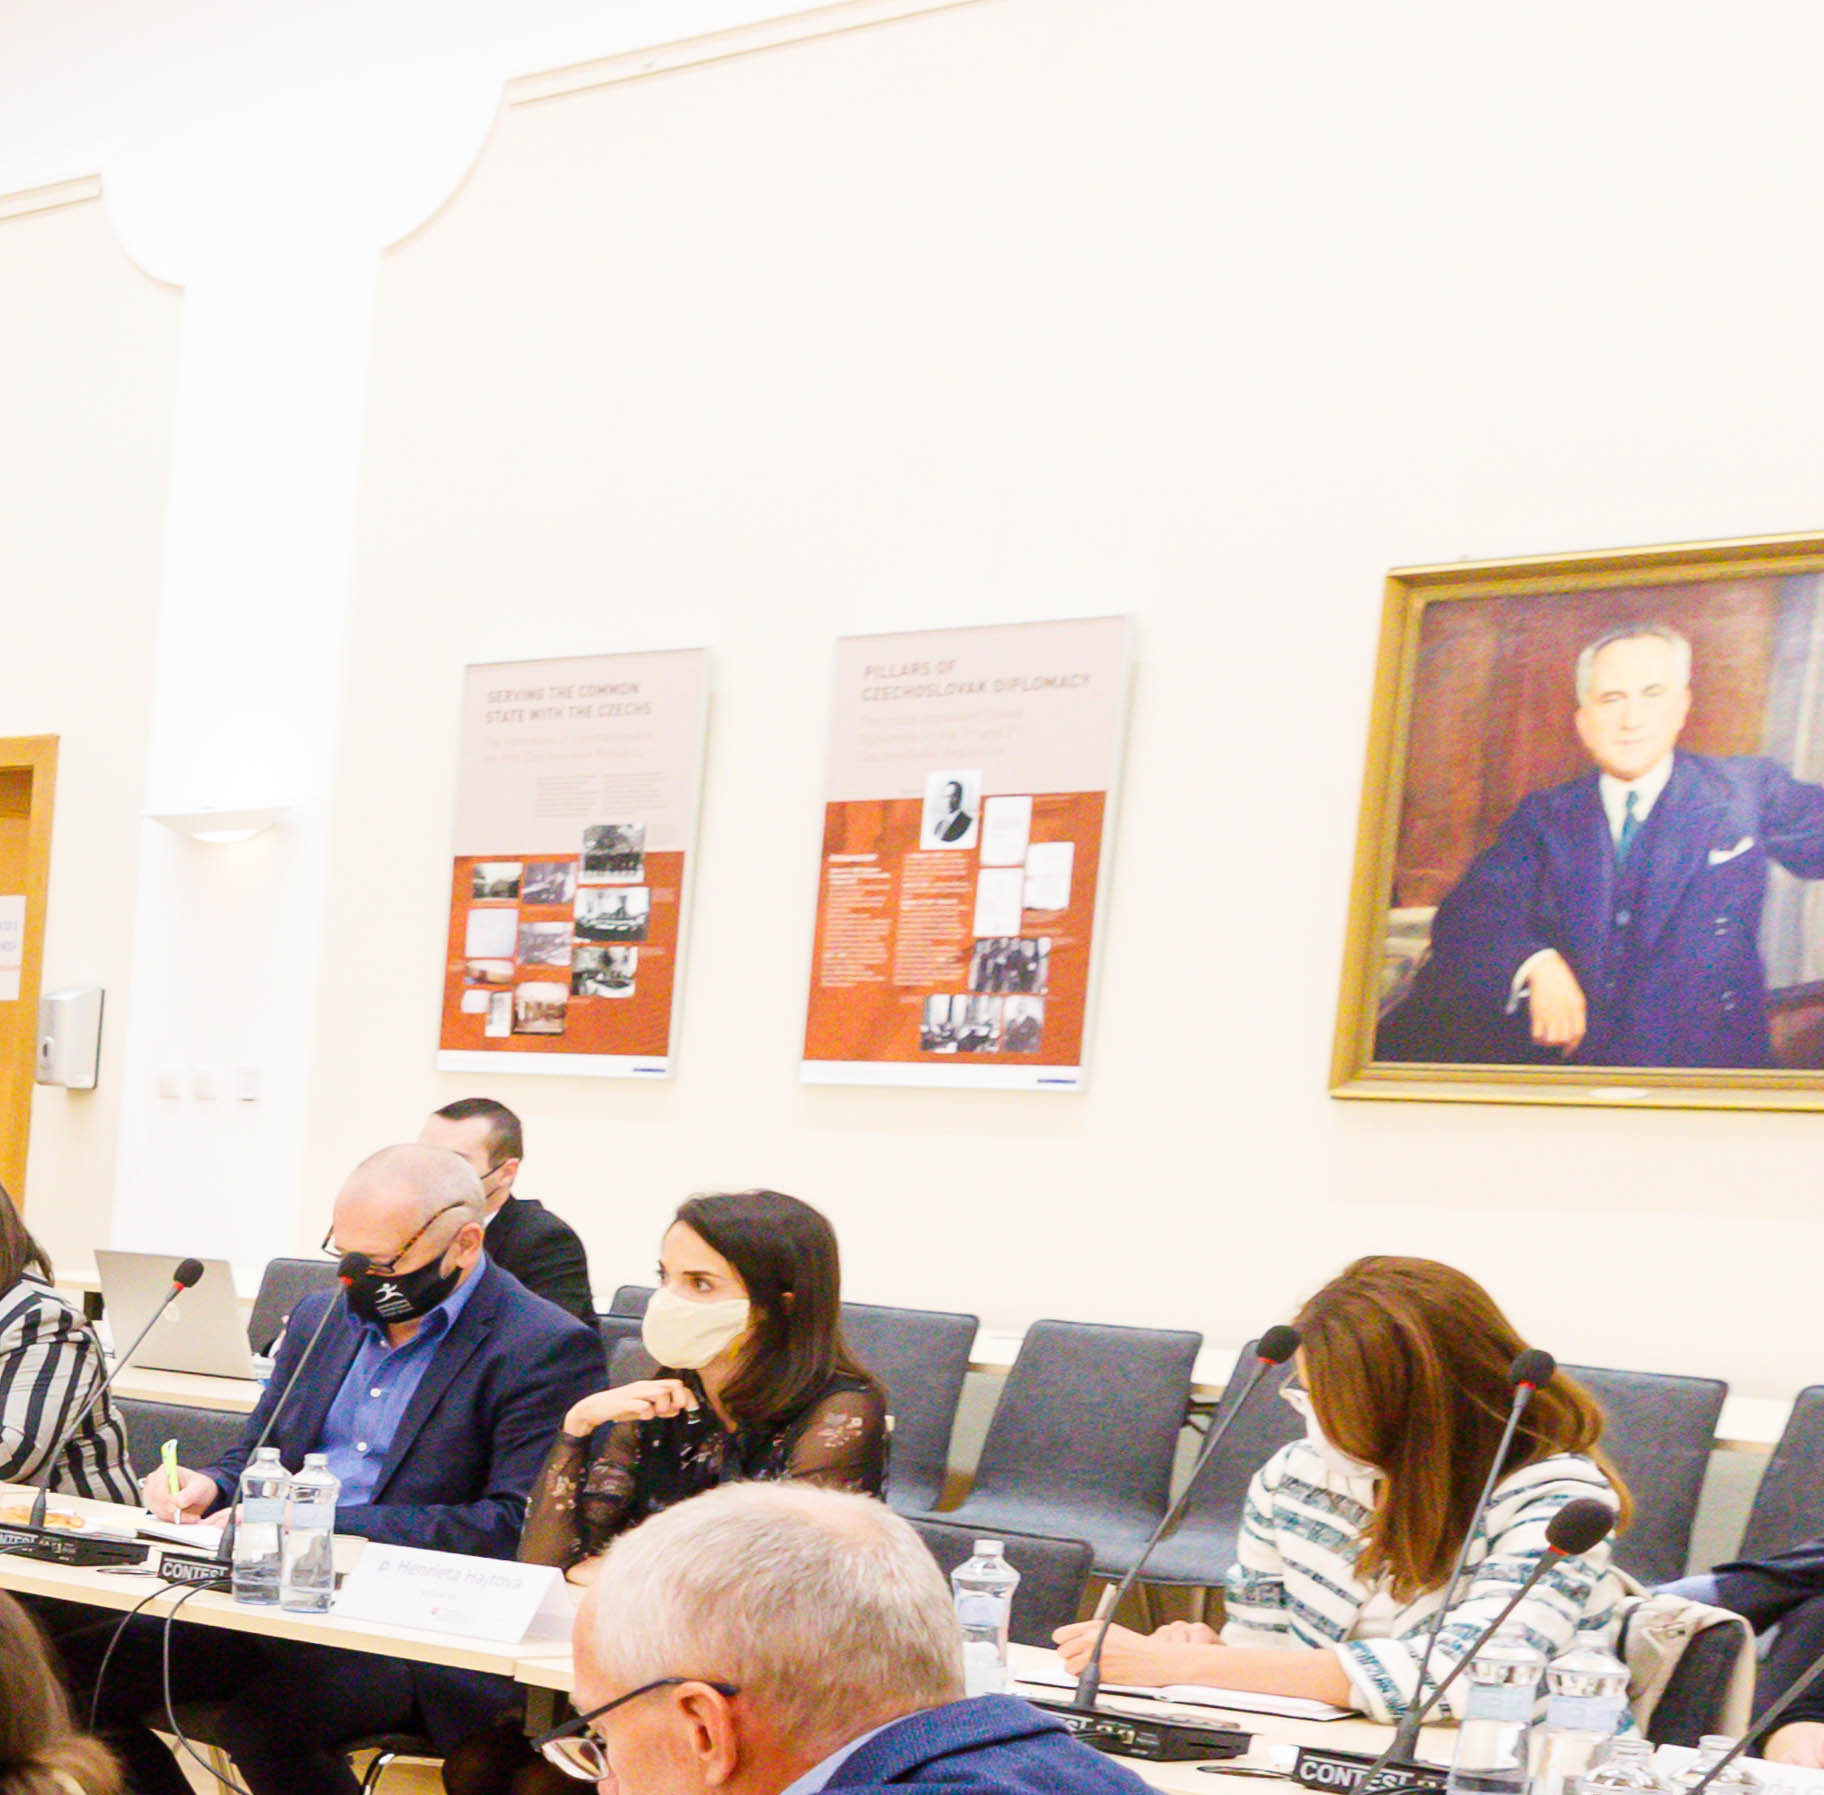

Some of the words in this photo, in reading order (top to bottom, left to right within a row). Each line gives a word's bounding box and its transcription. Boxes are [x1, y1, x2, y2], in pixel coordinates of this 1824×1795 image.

[864, 661, 930, 681] PILLARS
[936, 659, 958, 675] OF
[487, 686, 545, 704] SERVING
[549, 685, 573, 699] THE
[577, 681, 640, 698] COMMON
[861, 679, 987, 702] CZECHOSLOVAK
[992, 673, 1091, 694] DIPLOMACY
[485, 708, 526, 725] STATE
[530, 706, 564, 721] WITH
[568, 704, 594, 720] THE
[598, 701, 654, 718] CZECHS
[161, 1557, 229, 1581] CONTEST
